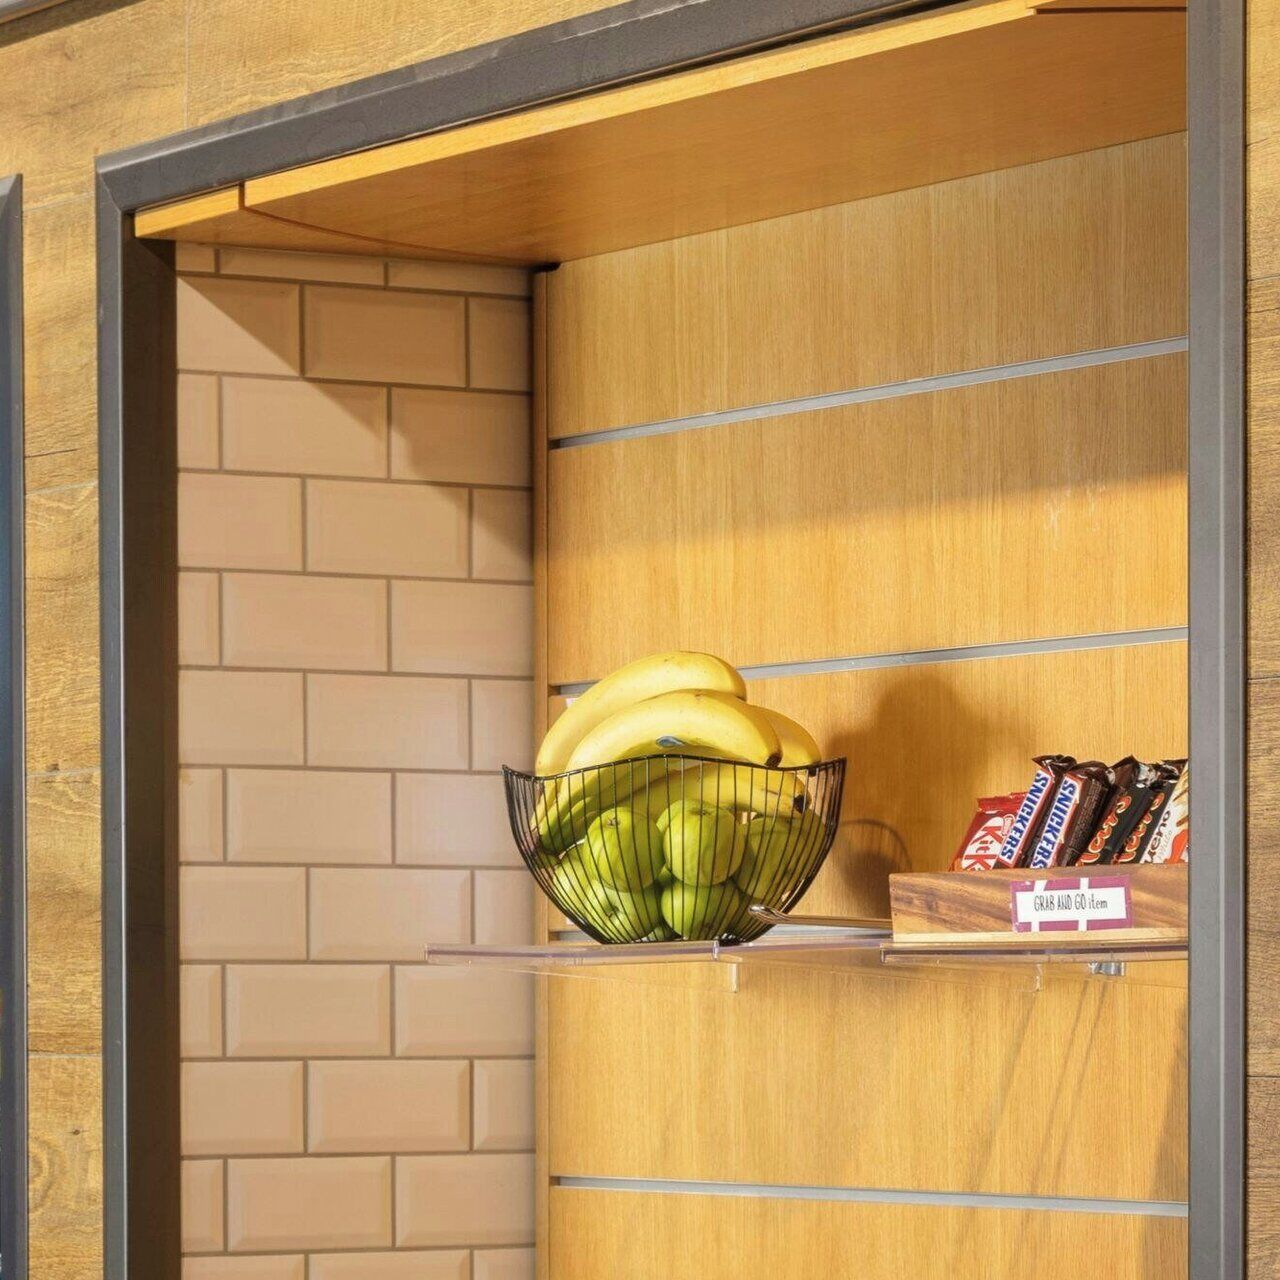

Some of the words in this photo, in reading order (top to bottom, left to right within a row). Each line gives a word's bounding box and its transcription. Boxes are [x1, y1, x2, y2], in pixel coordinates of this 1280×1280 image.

[1001, 771, 1051, 861] SNICKERS
[1030, 779, 1078, 870] SNICKERS
[1033, 894, 1055, 913] GRAB
[1057, 893, 1073, 911] AND
[1074, 893, 1087, 909] GO
[1088, 892, 1109, 911] item
